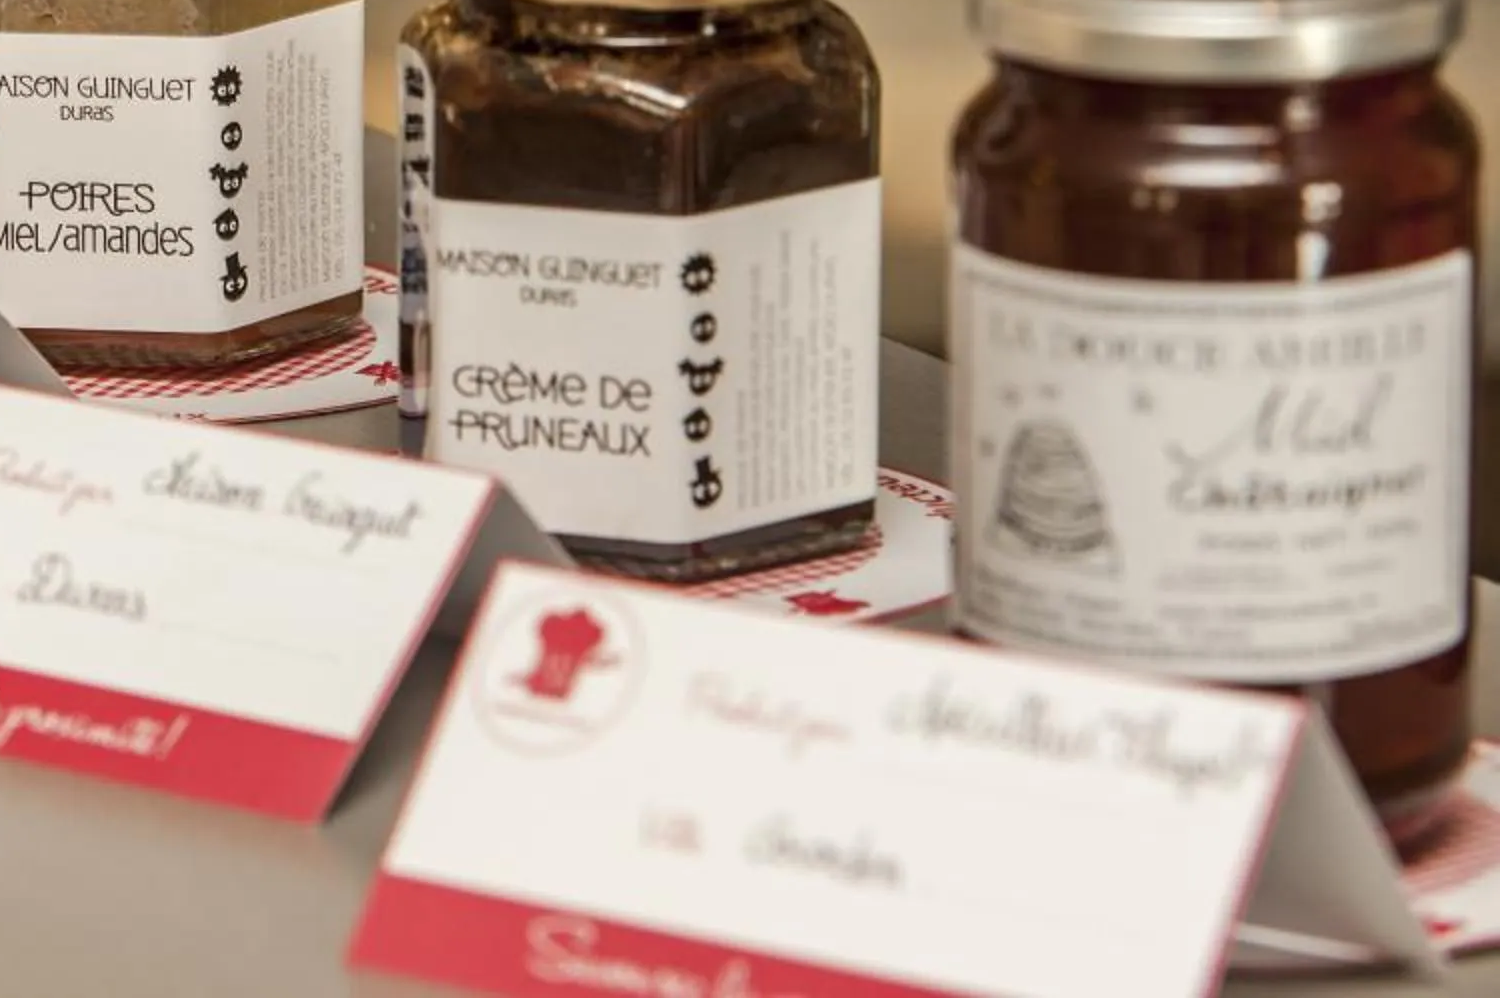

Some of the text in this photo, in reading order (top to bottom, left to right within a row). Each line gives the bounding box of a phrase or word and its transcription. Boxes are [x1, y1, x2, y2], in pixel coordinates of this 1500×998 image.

[19, 181, 156, 216] POIRES
[437, 249, 530, 280] MAISON
[448, 409, 651, 458] PRUNEAUX
